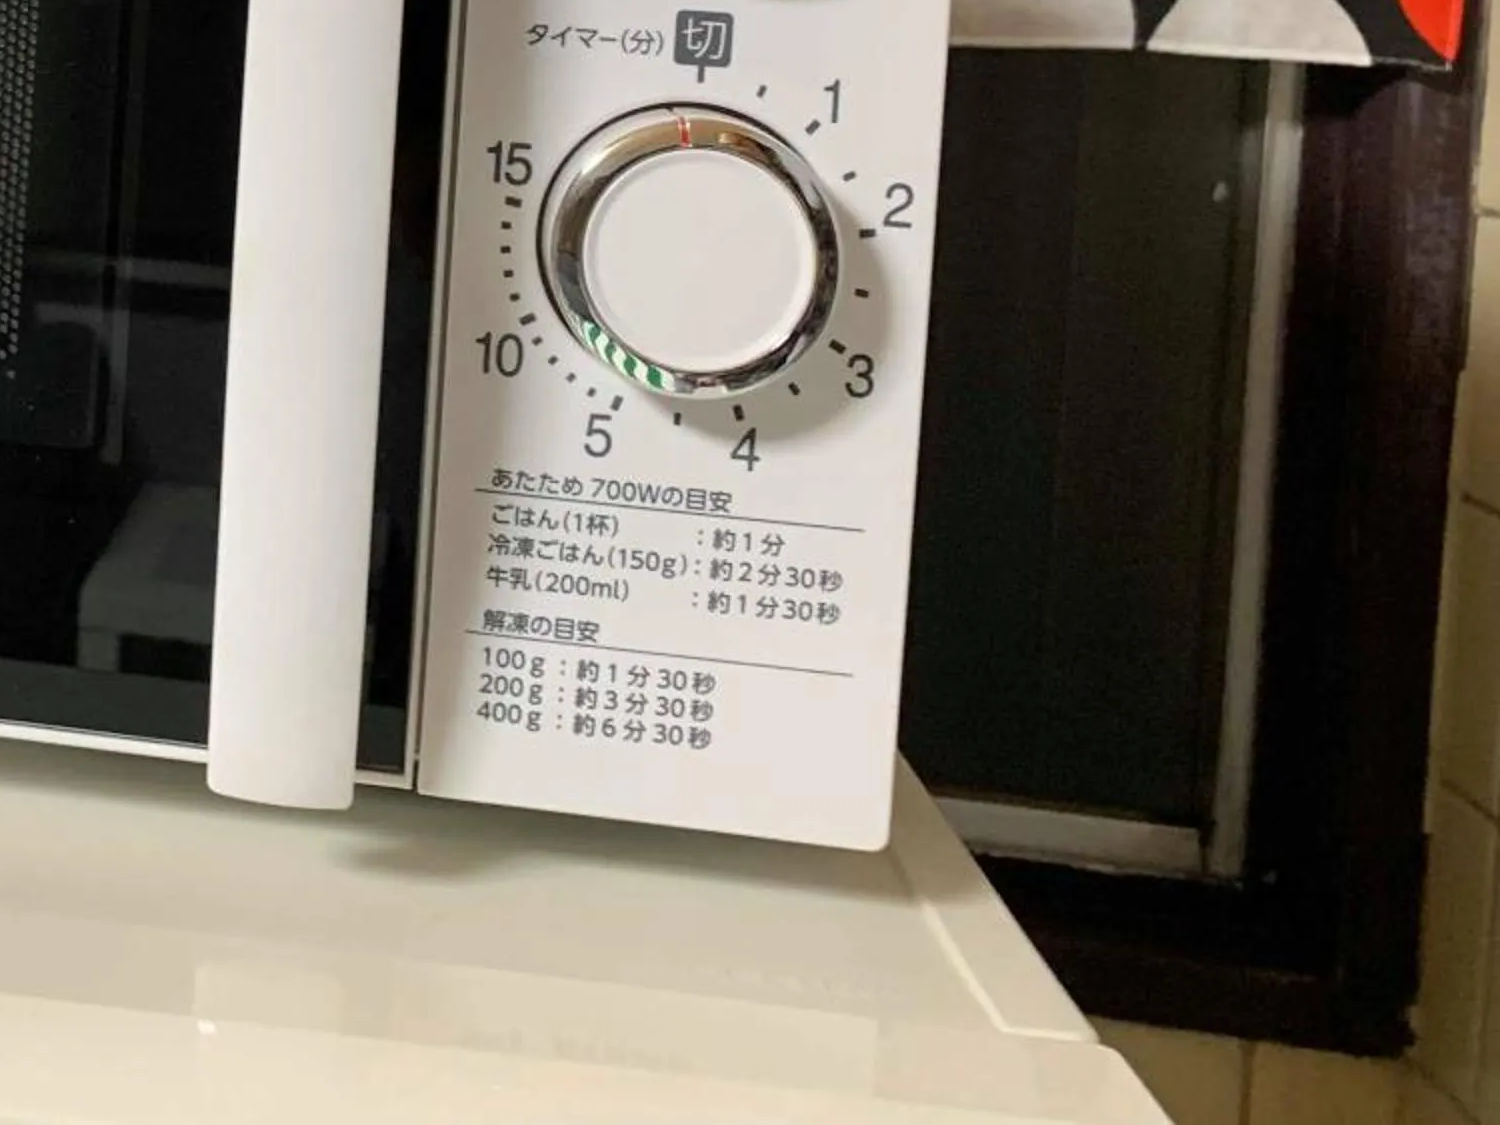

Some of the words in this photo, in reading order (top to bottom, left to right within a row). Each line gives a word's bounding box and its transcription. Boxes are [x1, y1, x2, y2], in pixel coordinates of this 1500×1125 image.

[525, 23, 665, 57] タイマー(分)
[681, 16, 730, 62] 切
[823, 79, 842, 124] 1
[486, 141, 533, 185] 15
[883, 183, 915, 229] 2
[475, 332, 524, 377] 10
[845, 354, 875, 398] 3
[583, 413, 613, 458] 5
[730, 427, 761, 472] 4
[482, 608, 600, 643] 解凍の目安
